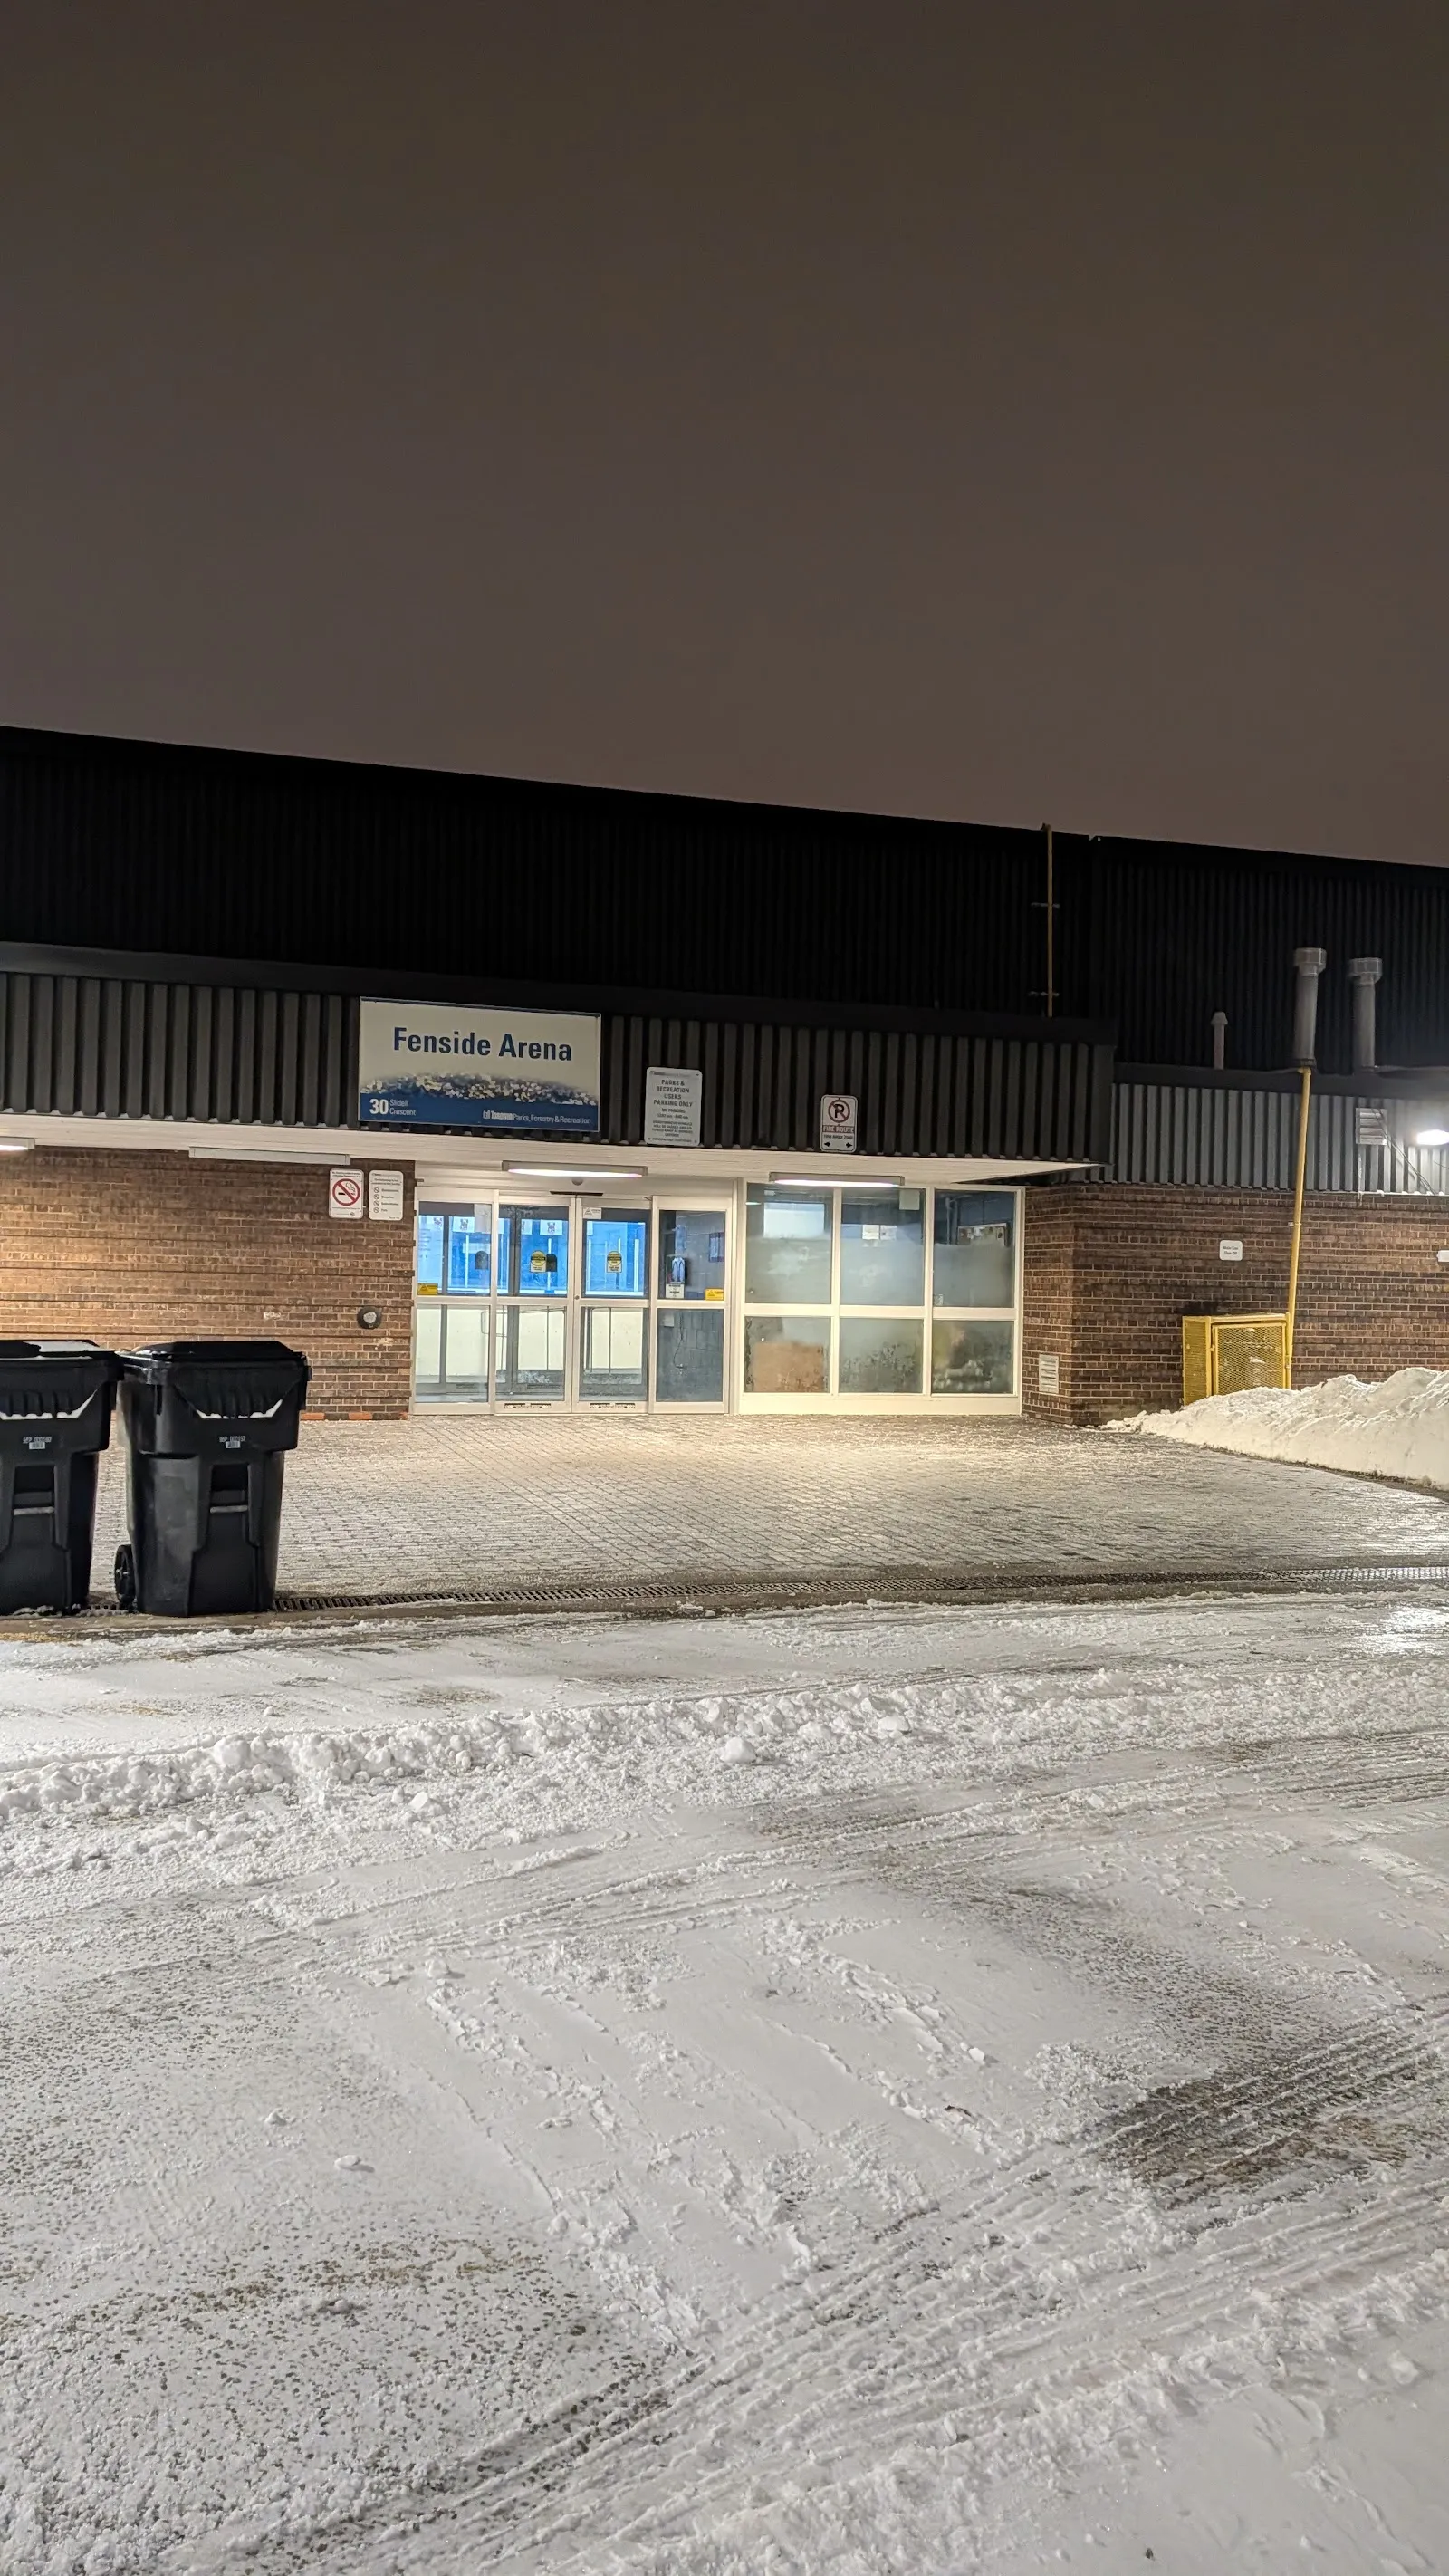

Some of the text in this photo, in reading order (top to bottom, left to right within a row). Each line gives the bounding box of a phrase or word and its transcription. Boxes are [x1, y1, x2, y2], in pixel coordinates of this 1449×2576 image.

[393, 1026, 571, 1062] Fenside Arena
[369, 1098, 389, 1115] 30
[389, 1107, 417, 1116] Crescent
[531, 1114, 554, 1124] Forestry
[554, 1115, 560, 1123] &
[560, 1115, 591, 1125] Recreation
